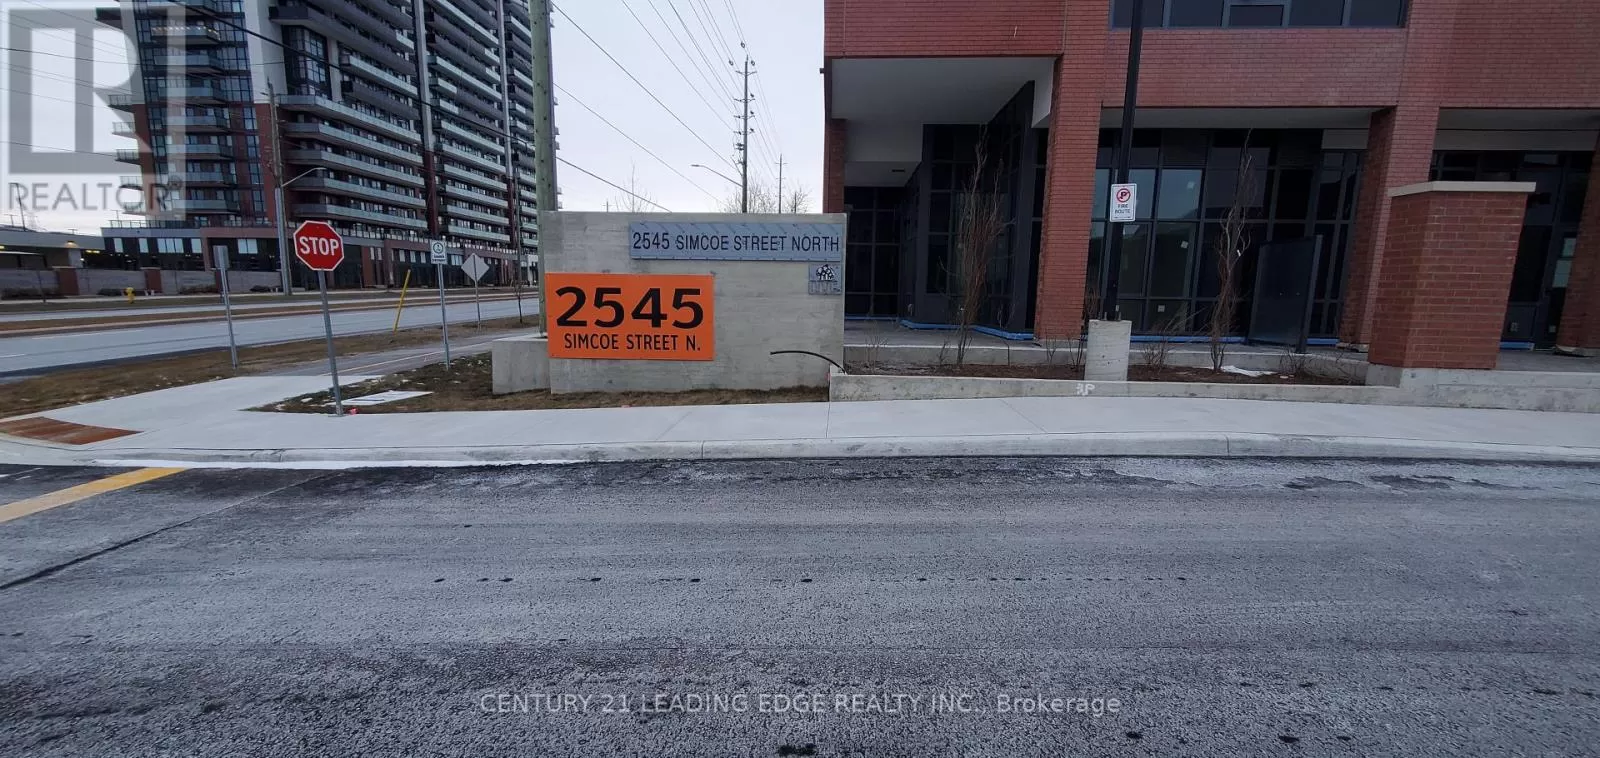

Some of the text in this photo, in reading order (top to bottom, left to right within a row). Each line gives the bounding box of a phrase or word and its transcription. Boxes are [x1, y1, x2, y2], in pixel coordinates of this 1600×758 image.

[299, 235, 340, 256] STOP
[632, 231, 840, 252] 2545 SIMCOE STREET NORTH
[554, 286, 704, 329] 2545
[564, 333, 701, 352] SIMCOE STREET N.
